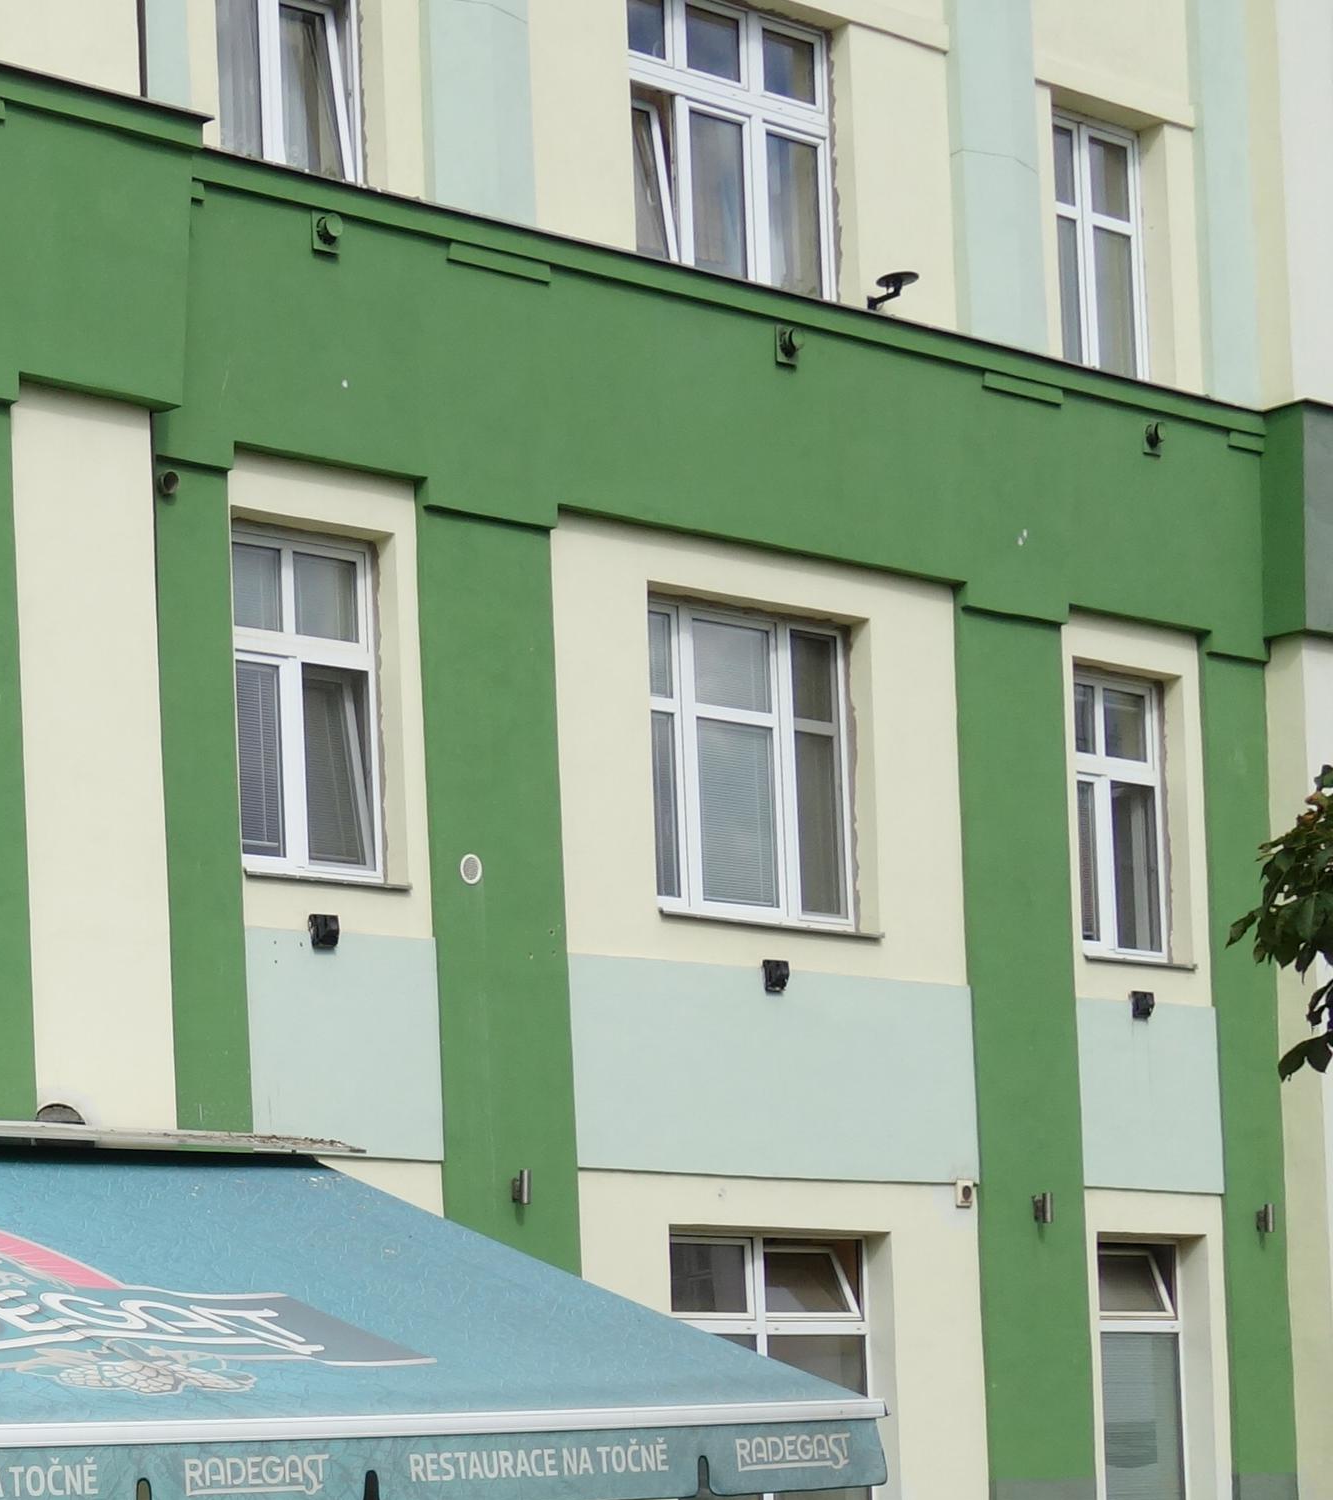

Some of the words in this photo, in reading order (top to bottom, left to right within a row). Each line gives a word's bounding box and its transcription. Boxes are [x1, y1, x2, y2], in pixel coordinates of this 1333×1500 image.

[409, 1449, 556, 1483] RESTAURACE
[562, 1447, 595, 1477] NA
[600, 1437, 670, 1474] TOČNĚ
[735, 1431, 850, 1472] RADEGAST
[9, 1456, 99, 1498] TOČNĚ
[184, 1453, 331, 1497] RADEGAST
